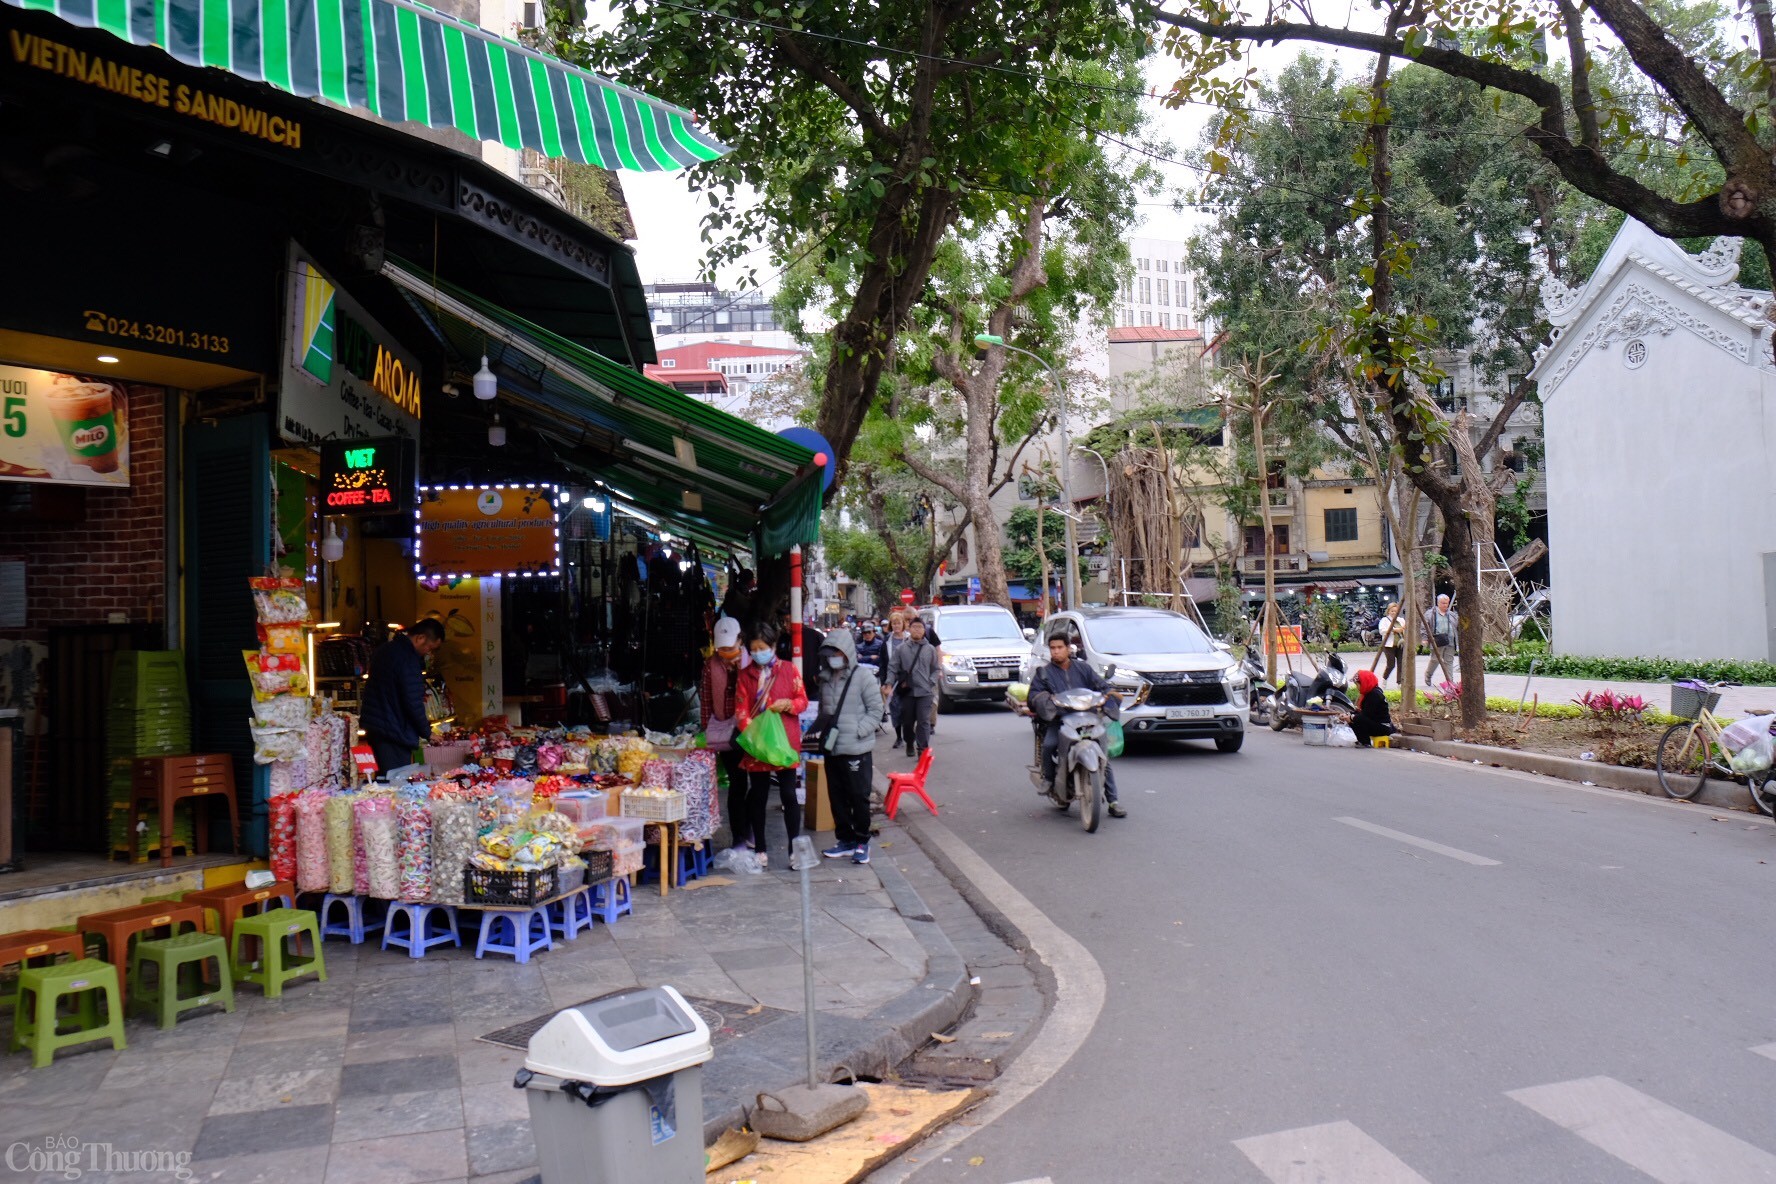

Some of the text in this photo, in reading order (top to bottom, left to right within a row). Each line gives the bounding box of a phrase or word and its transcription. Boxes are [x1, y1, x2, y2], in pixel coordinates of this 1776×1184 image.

[8, 28, 302, 150] VIETNAMESE SANDWICH
[107, 318, 230, 354] 024.3201.3133
[373, 343, 422, 420] AROMA
[75, 431, 105, 444] MILO
[344, 448, 376, 468] VIET
[327, 491, 365, 506] COFFEE
[371, 489, 391, 503] TEA
